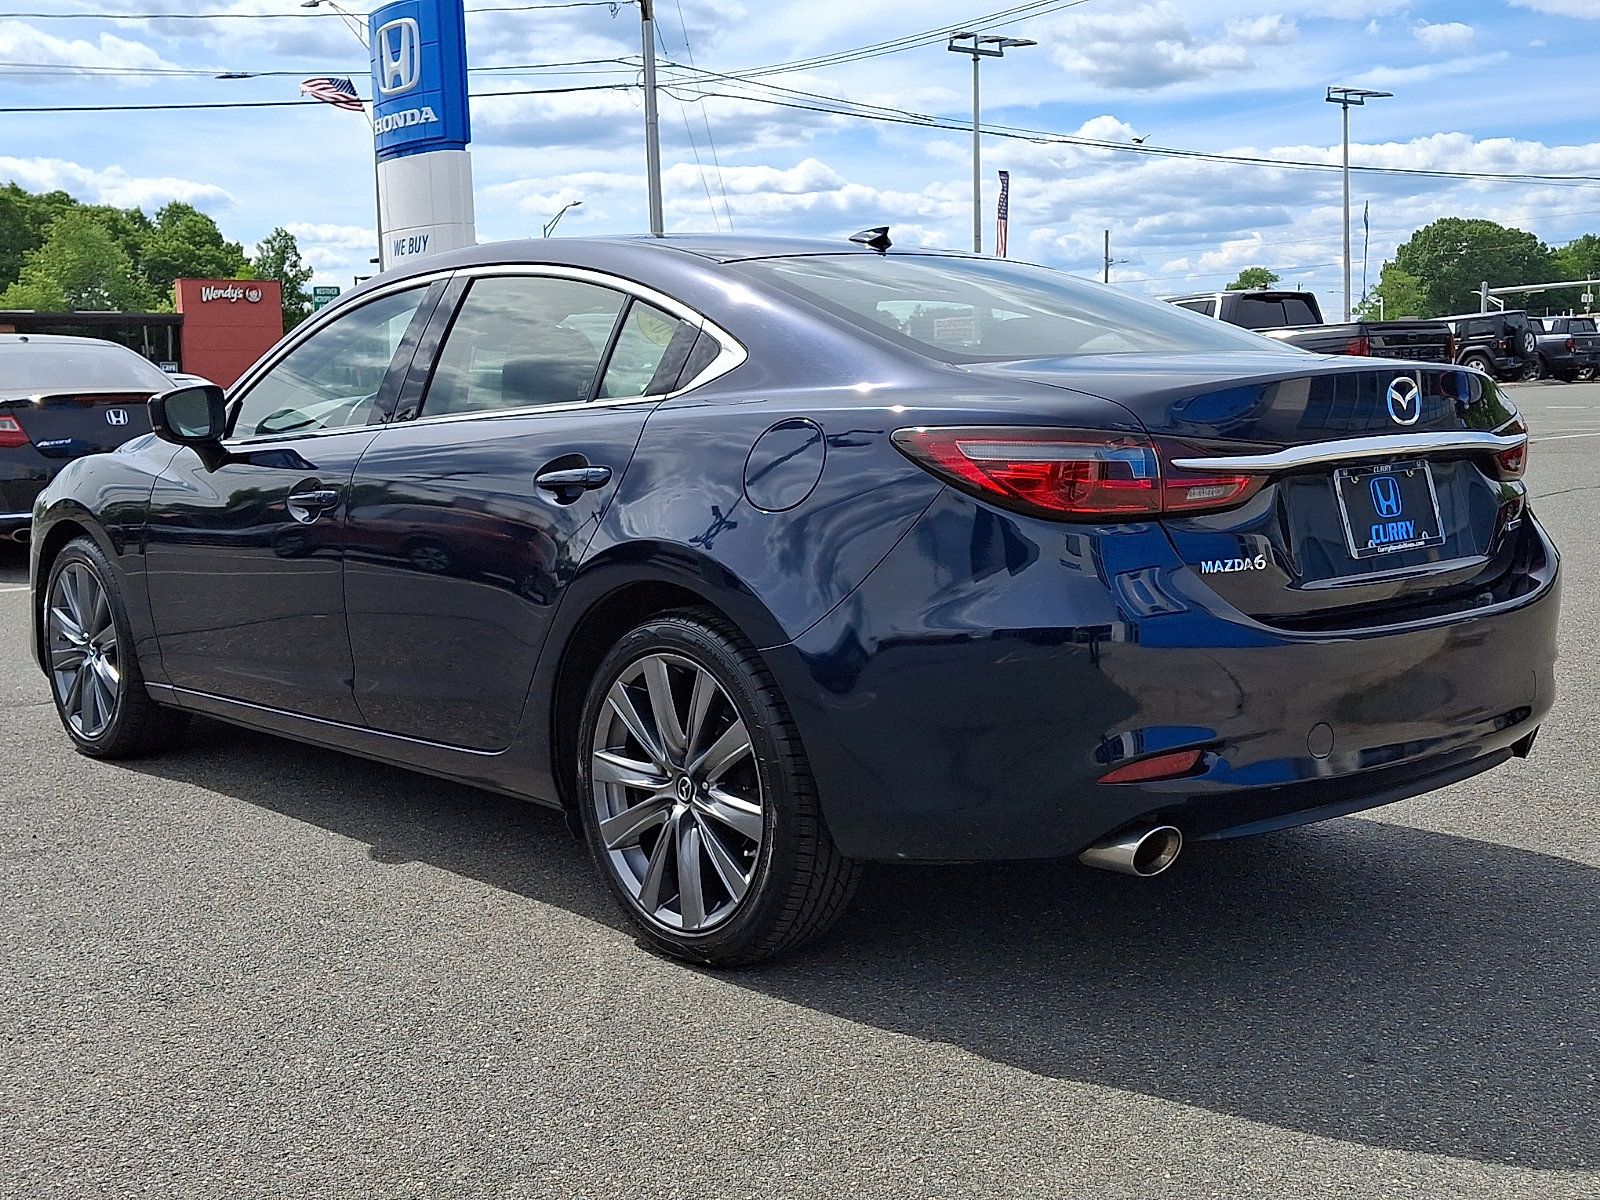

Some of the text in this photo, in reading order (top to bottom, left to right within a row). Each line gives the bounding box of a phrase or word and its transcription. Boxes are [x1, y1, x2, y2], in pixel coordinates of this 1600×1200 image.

[374, 106, 438, 136] HONDA
[393, 234, 429, 256] WE BUY
[202, 284, 244, 302] Wendy's
[36, 438, 72, 447] Accord
[1373, 465, 1392, 473] CURRY
[1371, 520, 1415, 544] CURRY
[1200, 554, 1267, 574] MAZDA6
